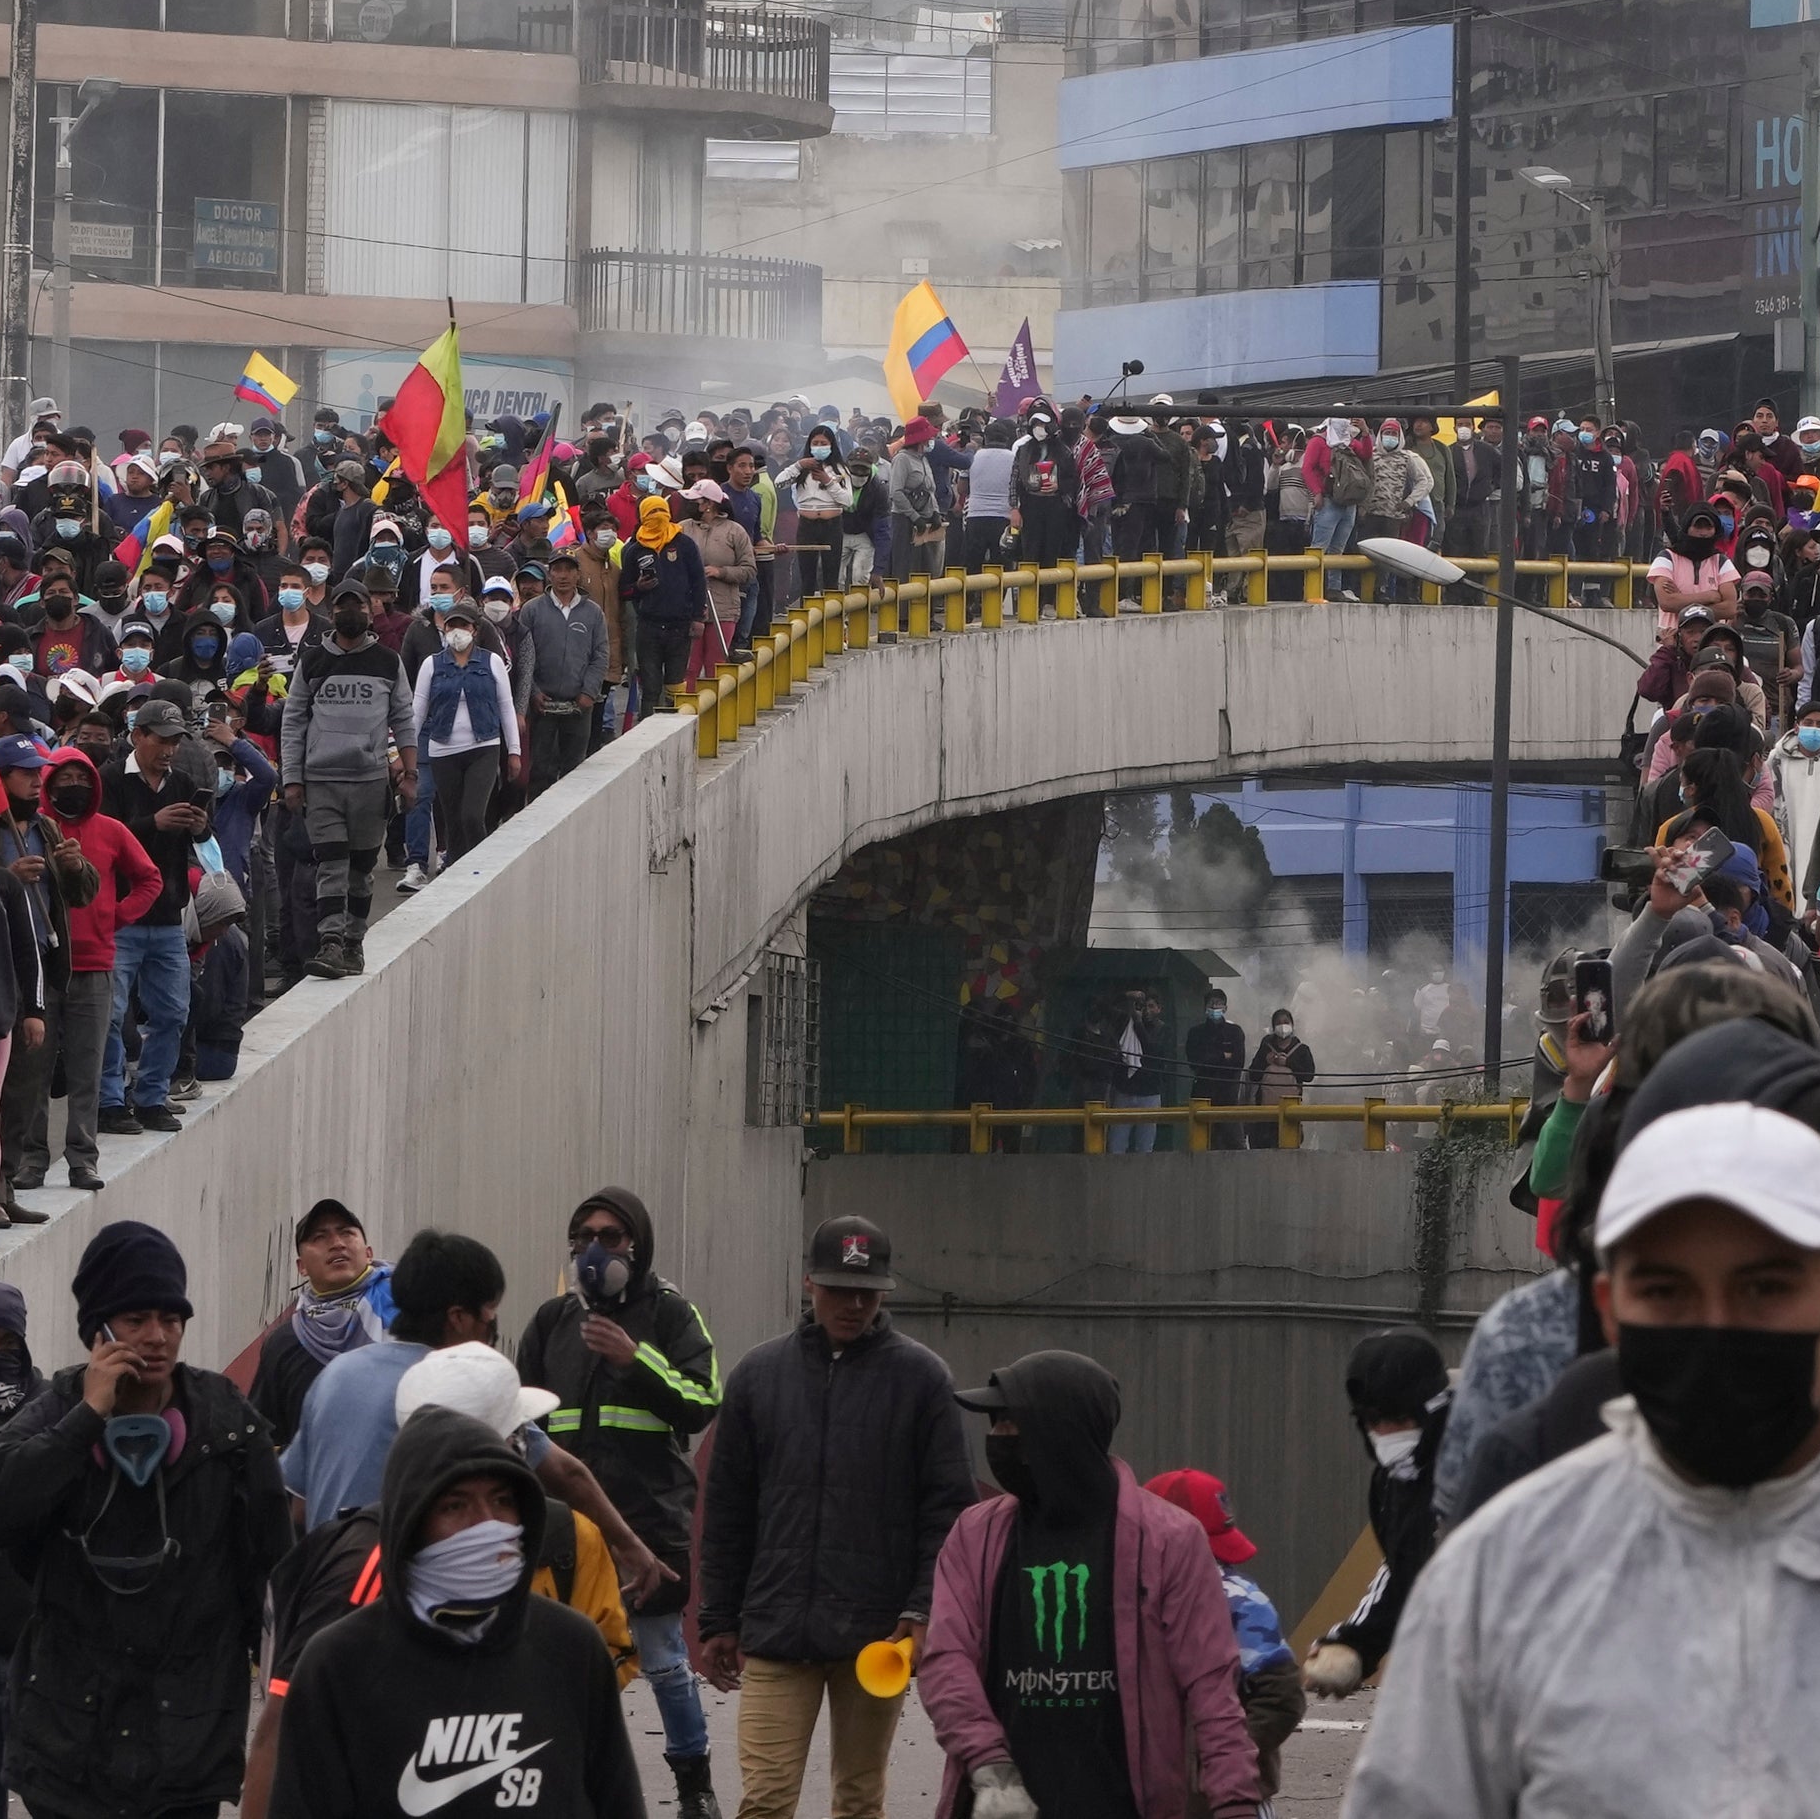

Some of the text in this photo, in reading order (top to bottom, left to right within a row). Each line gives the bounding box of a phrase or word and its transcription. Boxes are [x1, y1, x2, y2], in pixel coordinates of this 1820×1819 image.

[214, 205, 262, 222] DOCTOR
[207, 249, 264, 267] ABOGADO
[1776, 295, 1791, 314] 381
[1015, 342, 1030, 380] Mujeres
[492, 389, 550, 416] DENTAL
[1005, 1666, 1117, 1696] MONSTER
[1020, 1697, 1100, 1708] ENERGY
[418, 1712, 523, 1768] NIKE
[494, 1767, 542, 1808] SB
